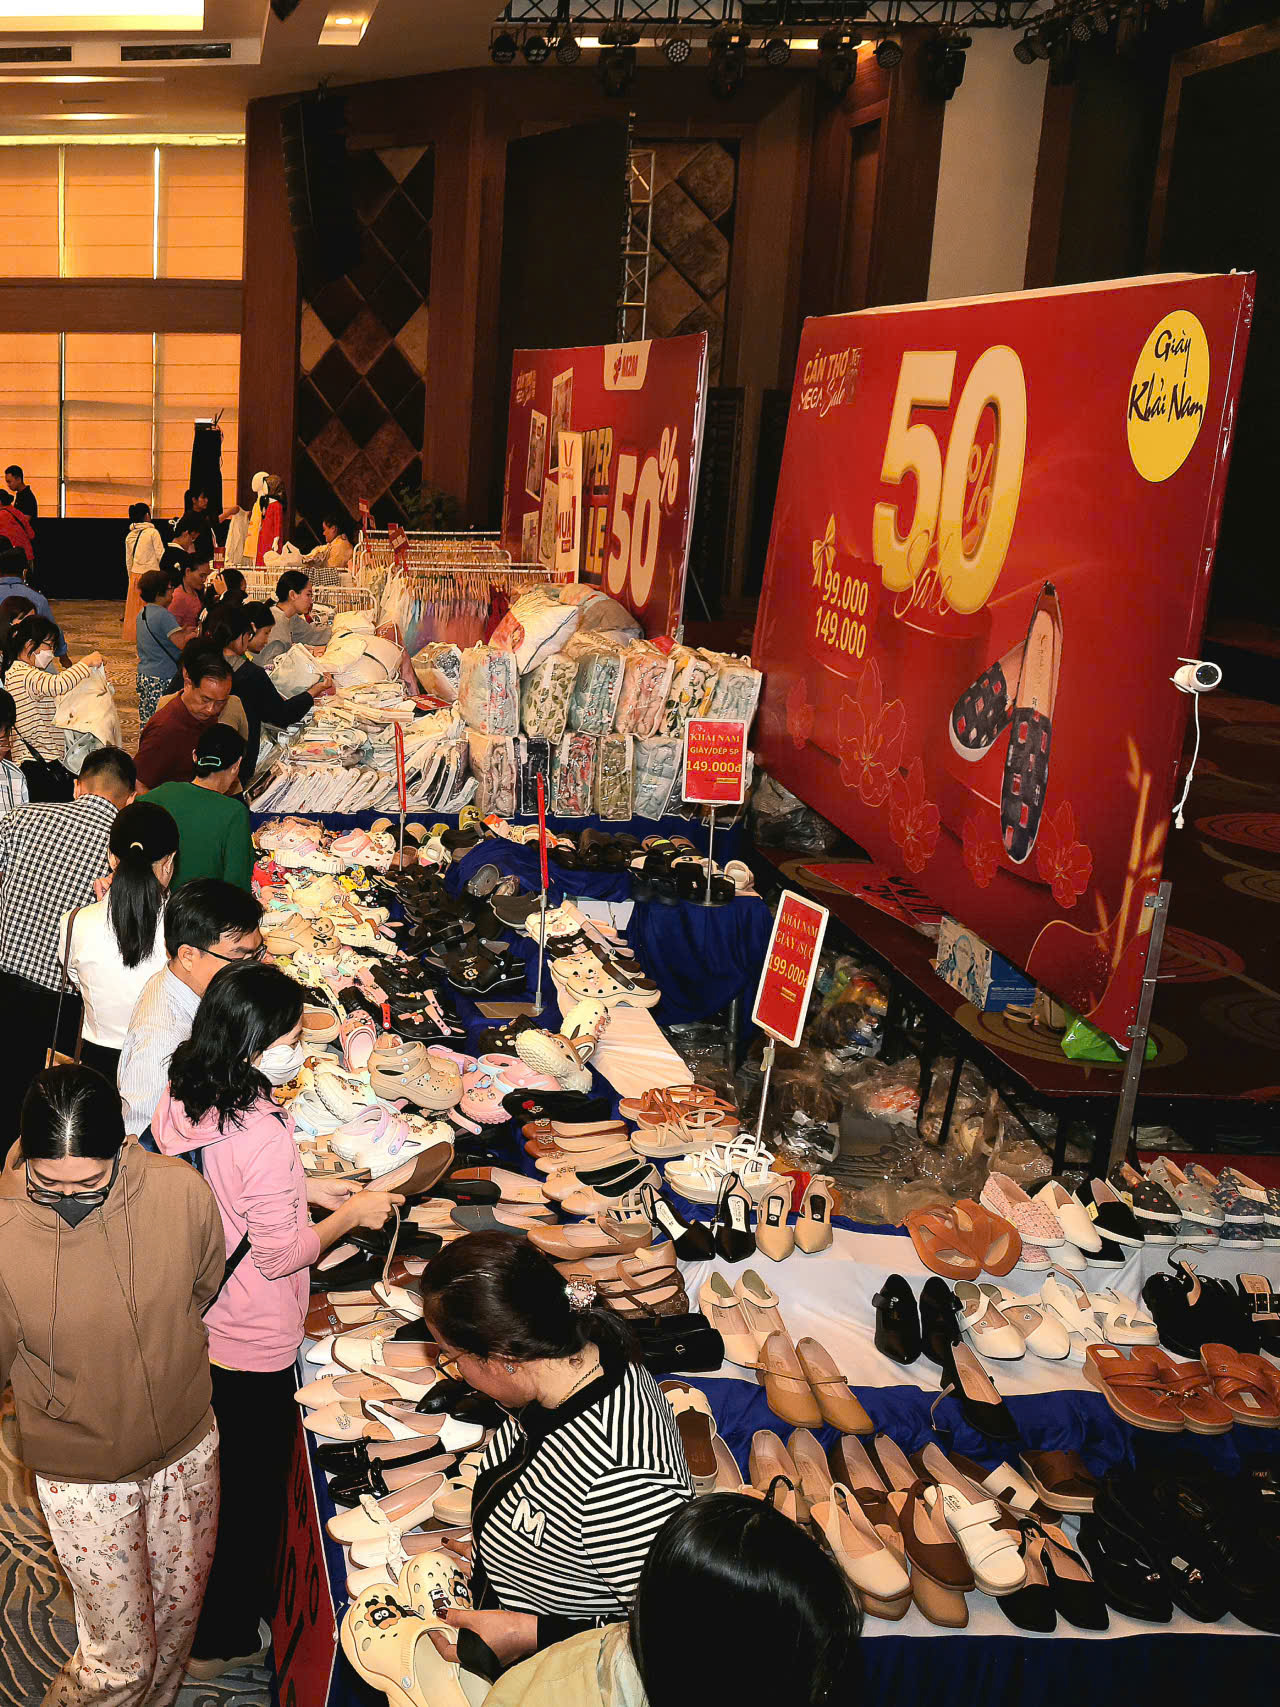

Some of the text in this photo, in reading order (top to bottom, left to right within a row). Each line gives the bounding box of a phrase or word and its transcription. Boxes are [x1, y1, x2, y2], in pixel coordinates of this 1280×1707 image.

[1154, 329, 1192, 378] Giày
[1128, 372, 1204, 427] Khải Nam
[823, 568, 869, 617] 99.000
[815, 606, 867, 659] 149.000
[511, 1497, 547, 1547] M
